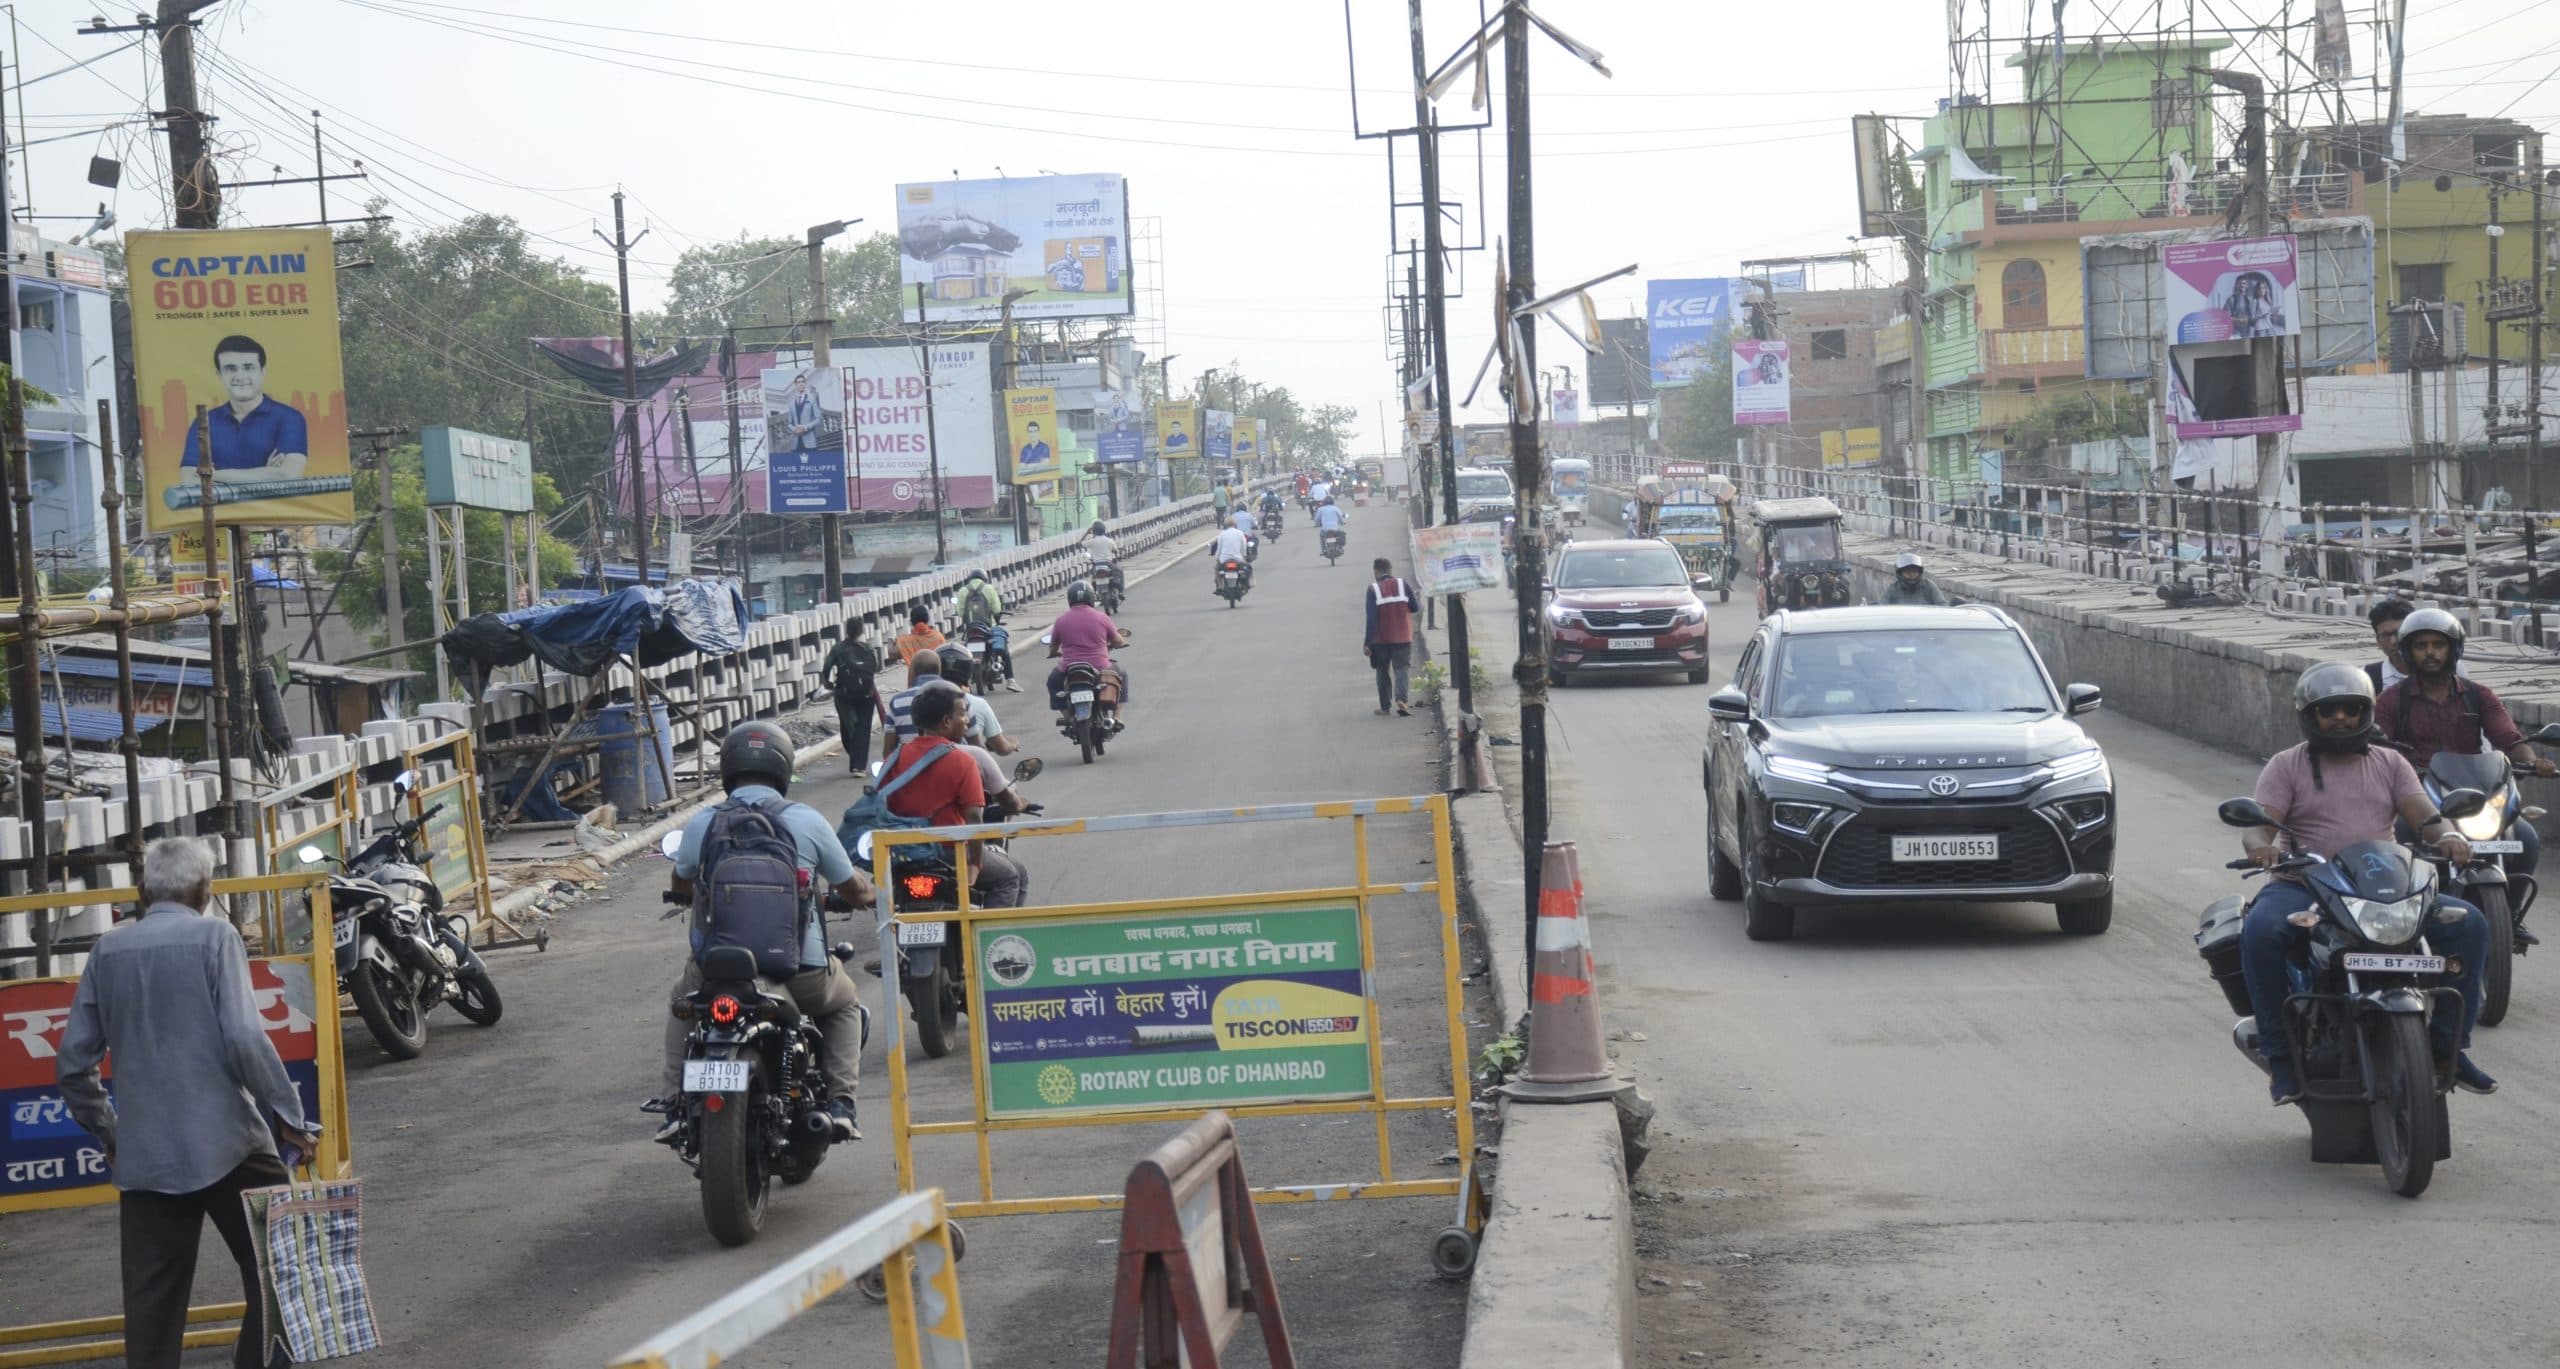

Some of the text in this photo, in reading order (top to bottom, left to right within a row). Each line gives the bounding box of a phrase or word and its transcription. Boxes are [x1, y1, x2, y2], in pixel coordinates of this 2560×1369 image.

[152, 254, 306, 277] CAPTAIN
[154, 278, 308, 310] 600 EQR
[156, 312, 203, 320] STRONGER
[250, 309, 278, 317] SUPER
[281, 308, 309, 316] SAVER
[1656, 296, 1720, 317] KEI
[852, 406, 923, 425] RIGHT
[800, 464, 837, 472] PHILIPPE
[1875, 757, 2007, 765] HYRYDER
[1904, 841, 1994, 857] JH10CU8553
[1052, 951, 1164, 977] धनबाद
[1167, 947, 1239, 970] नगर
[1244, 939, 1337, 967] निगम
[2385, 958, 2404, 968] BT
[992, 999, 1066, 1022] समझदार
[1115, 987, 1165, 1017] बेहतर
[1225, 995, 1281, 1016] TATA
[1225, 1019, 1306, 1039] TISCON
[700, 1063, 741, 1076] JH10D
[1080, 1060, 1326, 1092] ROTARY CLUB OF DHANBAD
[699, 1077, 739, 1089] B3131
[6, 1157, 65, 1183] टाटा
